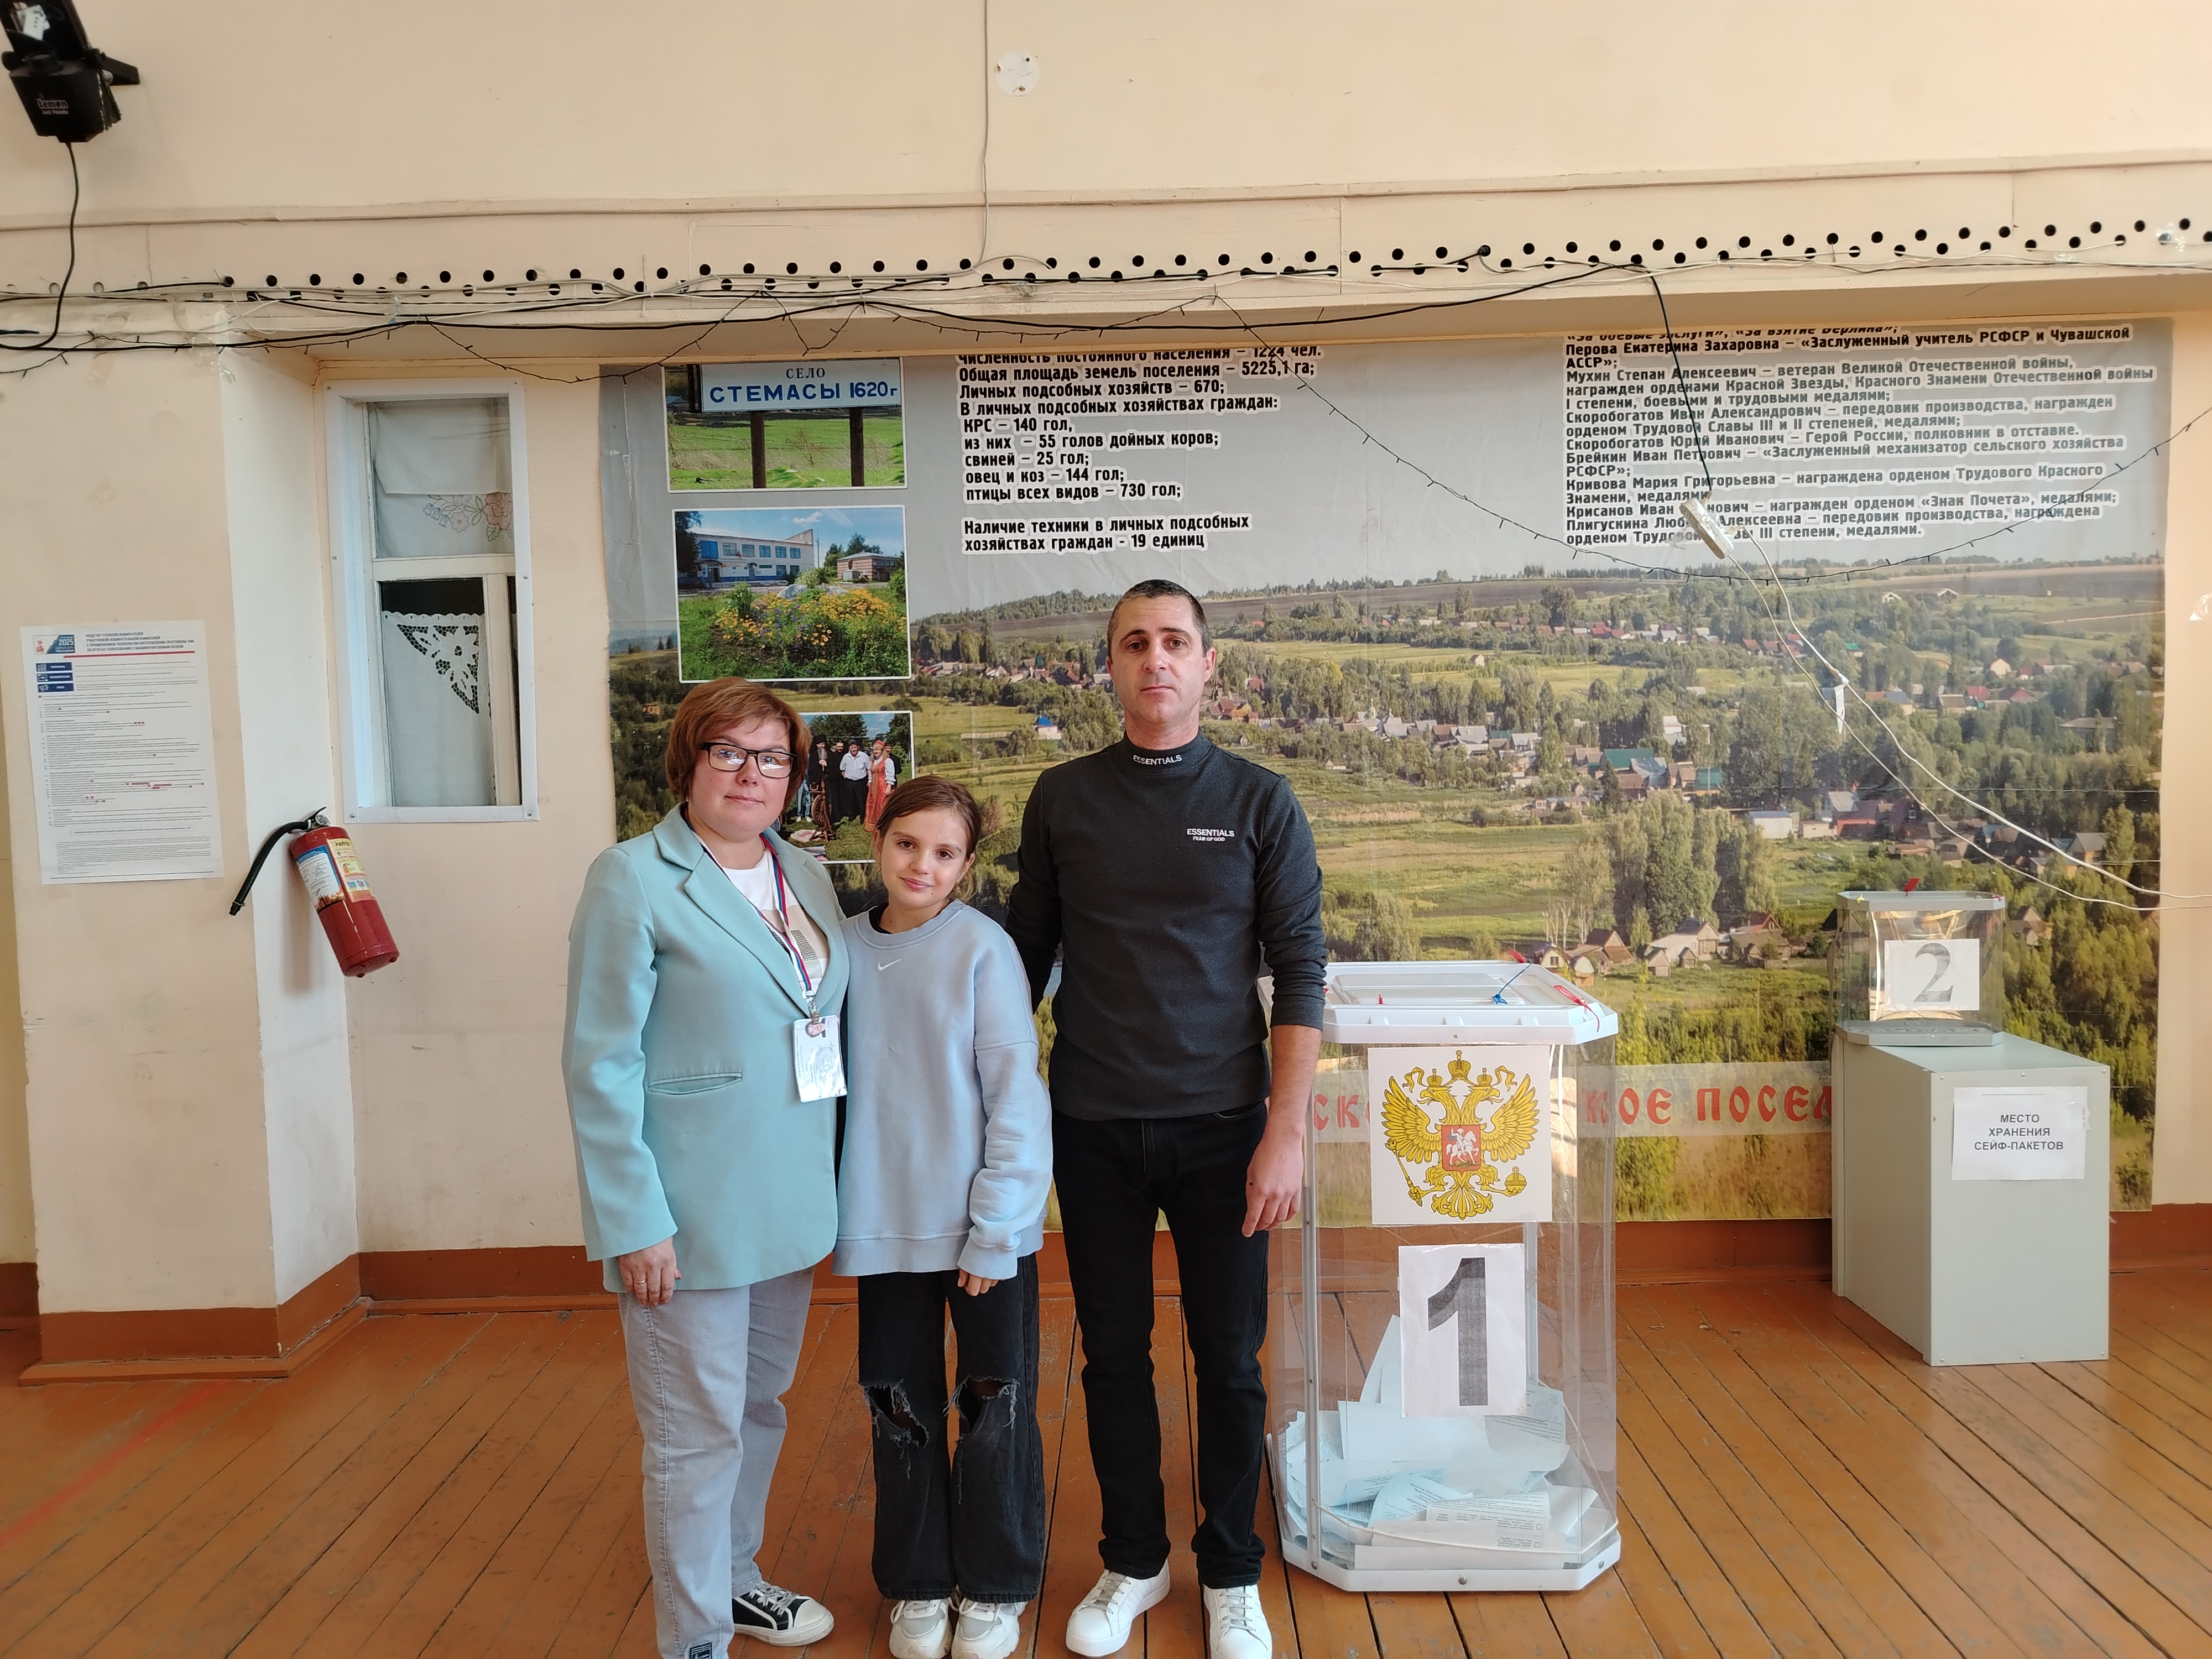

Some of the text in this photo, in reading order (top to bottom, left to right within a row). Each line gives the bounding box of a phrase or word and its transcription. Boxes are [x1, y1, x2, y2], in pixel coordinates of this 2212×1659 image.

[1566, 343, 1618, 358] Перова
[1623, 340, 1698, 355] Екатерина
[1704, 340, 1779, 352] Захаровна
[1915, 334, 1969, 347] учитель
[1980, 330, 2030, 343] РСФСР
[2036, 331, 2044, 342] и
[2050, 327, 2130, 342] Чувашской
[1154, 348, 1230, 361] населения
[1291, 345, 1321, 357] чел.
[785, 367, 826, 379] СЕЛО
[959, 367, 1007, 383] Общая
[1014, 368, 1079, 382] площадь
[1084, 367, 1137, 379] земель
[1143, 364, 1220, 378] поселения
[1567, 357, 2073, 384] Мухин Степан Алексеевич ветеран Великой Отечественной войны,
[959, 379, 1224, 399] Личных подсобных хозяйств 670;
[1566, 368, 2153, 398] награжден орденами Красной Звезды, Красного Знамени Отечественной войны
[709, 383, 840, 403] СТЕМАСЫ
[1566, 390, 1890, 410] I степени, боевыми и трудовыми медалями;
[961, 397, 1277, 416] В личных подсобных хозяйствах граждан:
[1566, 398, 2112, 425] Скоробогатов Иван Александрович передовик производства, награжден
[964, 417, 1072, 433] КРС 140 гол,
[1566, 416, 1960, 439] орденом Трудовой Славы III и II степеней, медалями;
[964, 432, 1218, 450] из них 55 голов дойных коров;
[1566, 426, 2079, 452] Скоробогатов Юрий Иванович Герой России, полковник в отставке.
[965, 451, 1089, 467] свиней 25 гол;
[1566, 451, 1626, 466] Брейкин
[1633, 450, 1667, 462] Иван
[1673, 449, 1741, 462] Петрович
[1877, 442, 1967, 455] механизатор
[1974, 440, 2046, 452] сельского
[2052, 437, 2123, 449] хозяйства
[966, 467, 1124, 485] овец и коз 144 гол;
[1566, 466, 2103, 493] Кривова Мария Григорьевна награждена орденом Трудового Красного
[966, 483, 1181, 502] птицы всех видов 730 гол;
[1566, 493, 1631, 504] Знамени,
[1566, 506, 1634, 520] Крисанов
[1640, 504, 1674, 515] Иван
[1770, 500, 1848, 513] награжден
[1854, 498, 1914, 511] орденом
[2041, 492, 2116, 504] медалями;
[964, 515, 1249, 534] Наличие техники в личных подсобных
[1566, 519, 1648, 533] Плигускина
[1823, 512, 1899, 525] передовик
[1905, 509, 2008, 523] производства,
[2015, 505, 2100, 520] награждена
[965, 534, 1204, 552] хозяйствах граждан 19 единиц
[1566, 534, 1627, 546] орденом
[1760, 526, 1772, 539] III
[1779, 528, 1840, 538] степени,
[1846, 525, 1922, 537] медалями.
[1133, 755, 1182, 765] ESSENTIALS
[1187, 828, 1235, 837] ESSENTIALS
[1913, 942, 1954, 1003] 2
[2000, 1114, 2040, 1123] МЕСТО
[1988, 1128, 2051, 1137] ХРАНЕНИЯ
[1974, 1139, 2064, 1150] СЕЙФ-ПАКЕТОВ
[1427, 1256, 1489, 1407] 1
